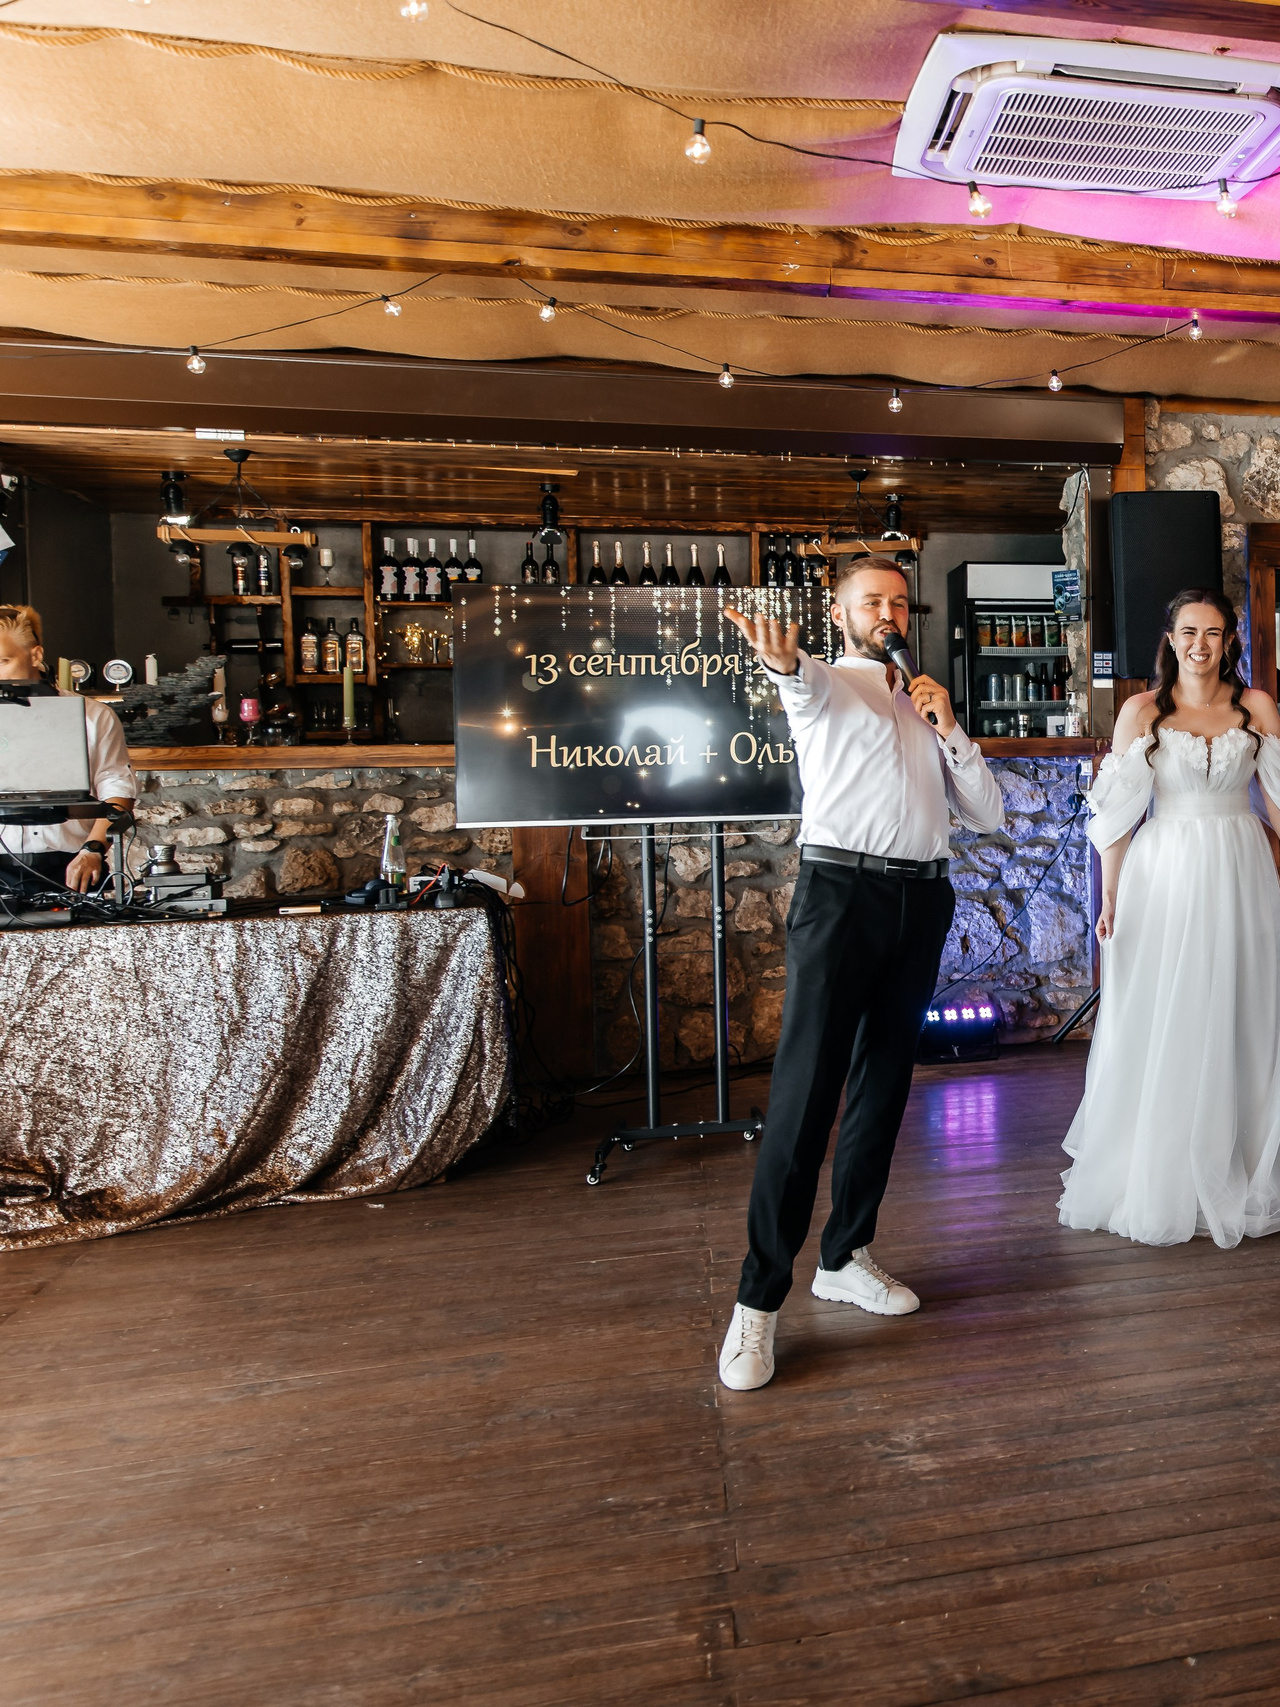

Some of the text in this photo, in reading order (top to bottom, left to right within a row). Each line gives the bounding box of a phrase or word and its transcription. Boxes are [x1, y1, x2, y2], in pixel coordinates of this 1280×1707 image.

[524, 653, 559, 686] 13
[568, 637, 744, 688] сентября
[526, 731, 796, 769] Николай + Оль
